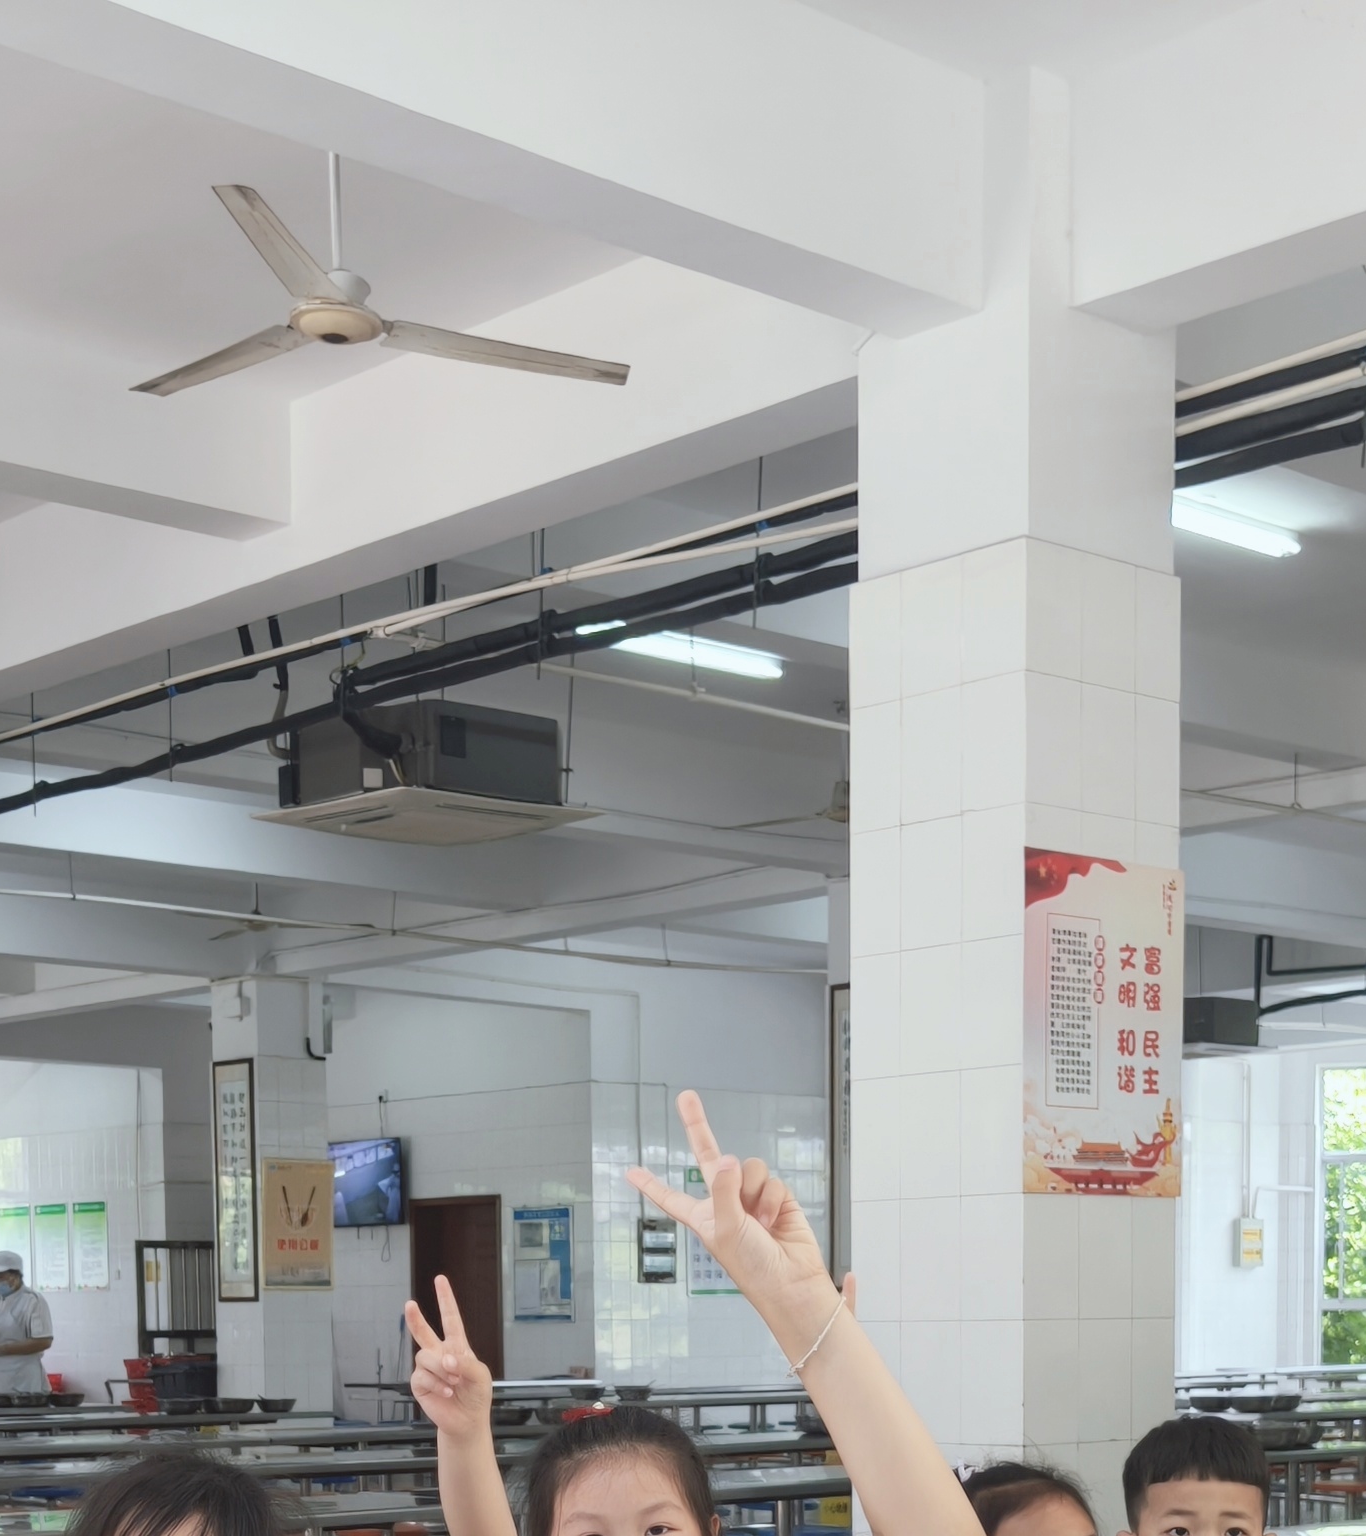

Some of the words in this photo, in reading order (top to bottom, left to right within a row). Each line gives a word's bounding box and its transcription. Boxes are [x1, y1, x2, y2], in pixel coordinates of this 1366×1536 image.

[1118, 943, 1137, 1009] 文明
[1143, 945, 1162, 1012] 富强
[1117, 1028, 1136, 1094] 和谐
[1142, 1029, 1161, 1095] 民主
